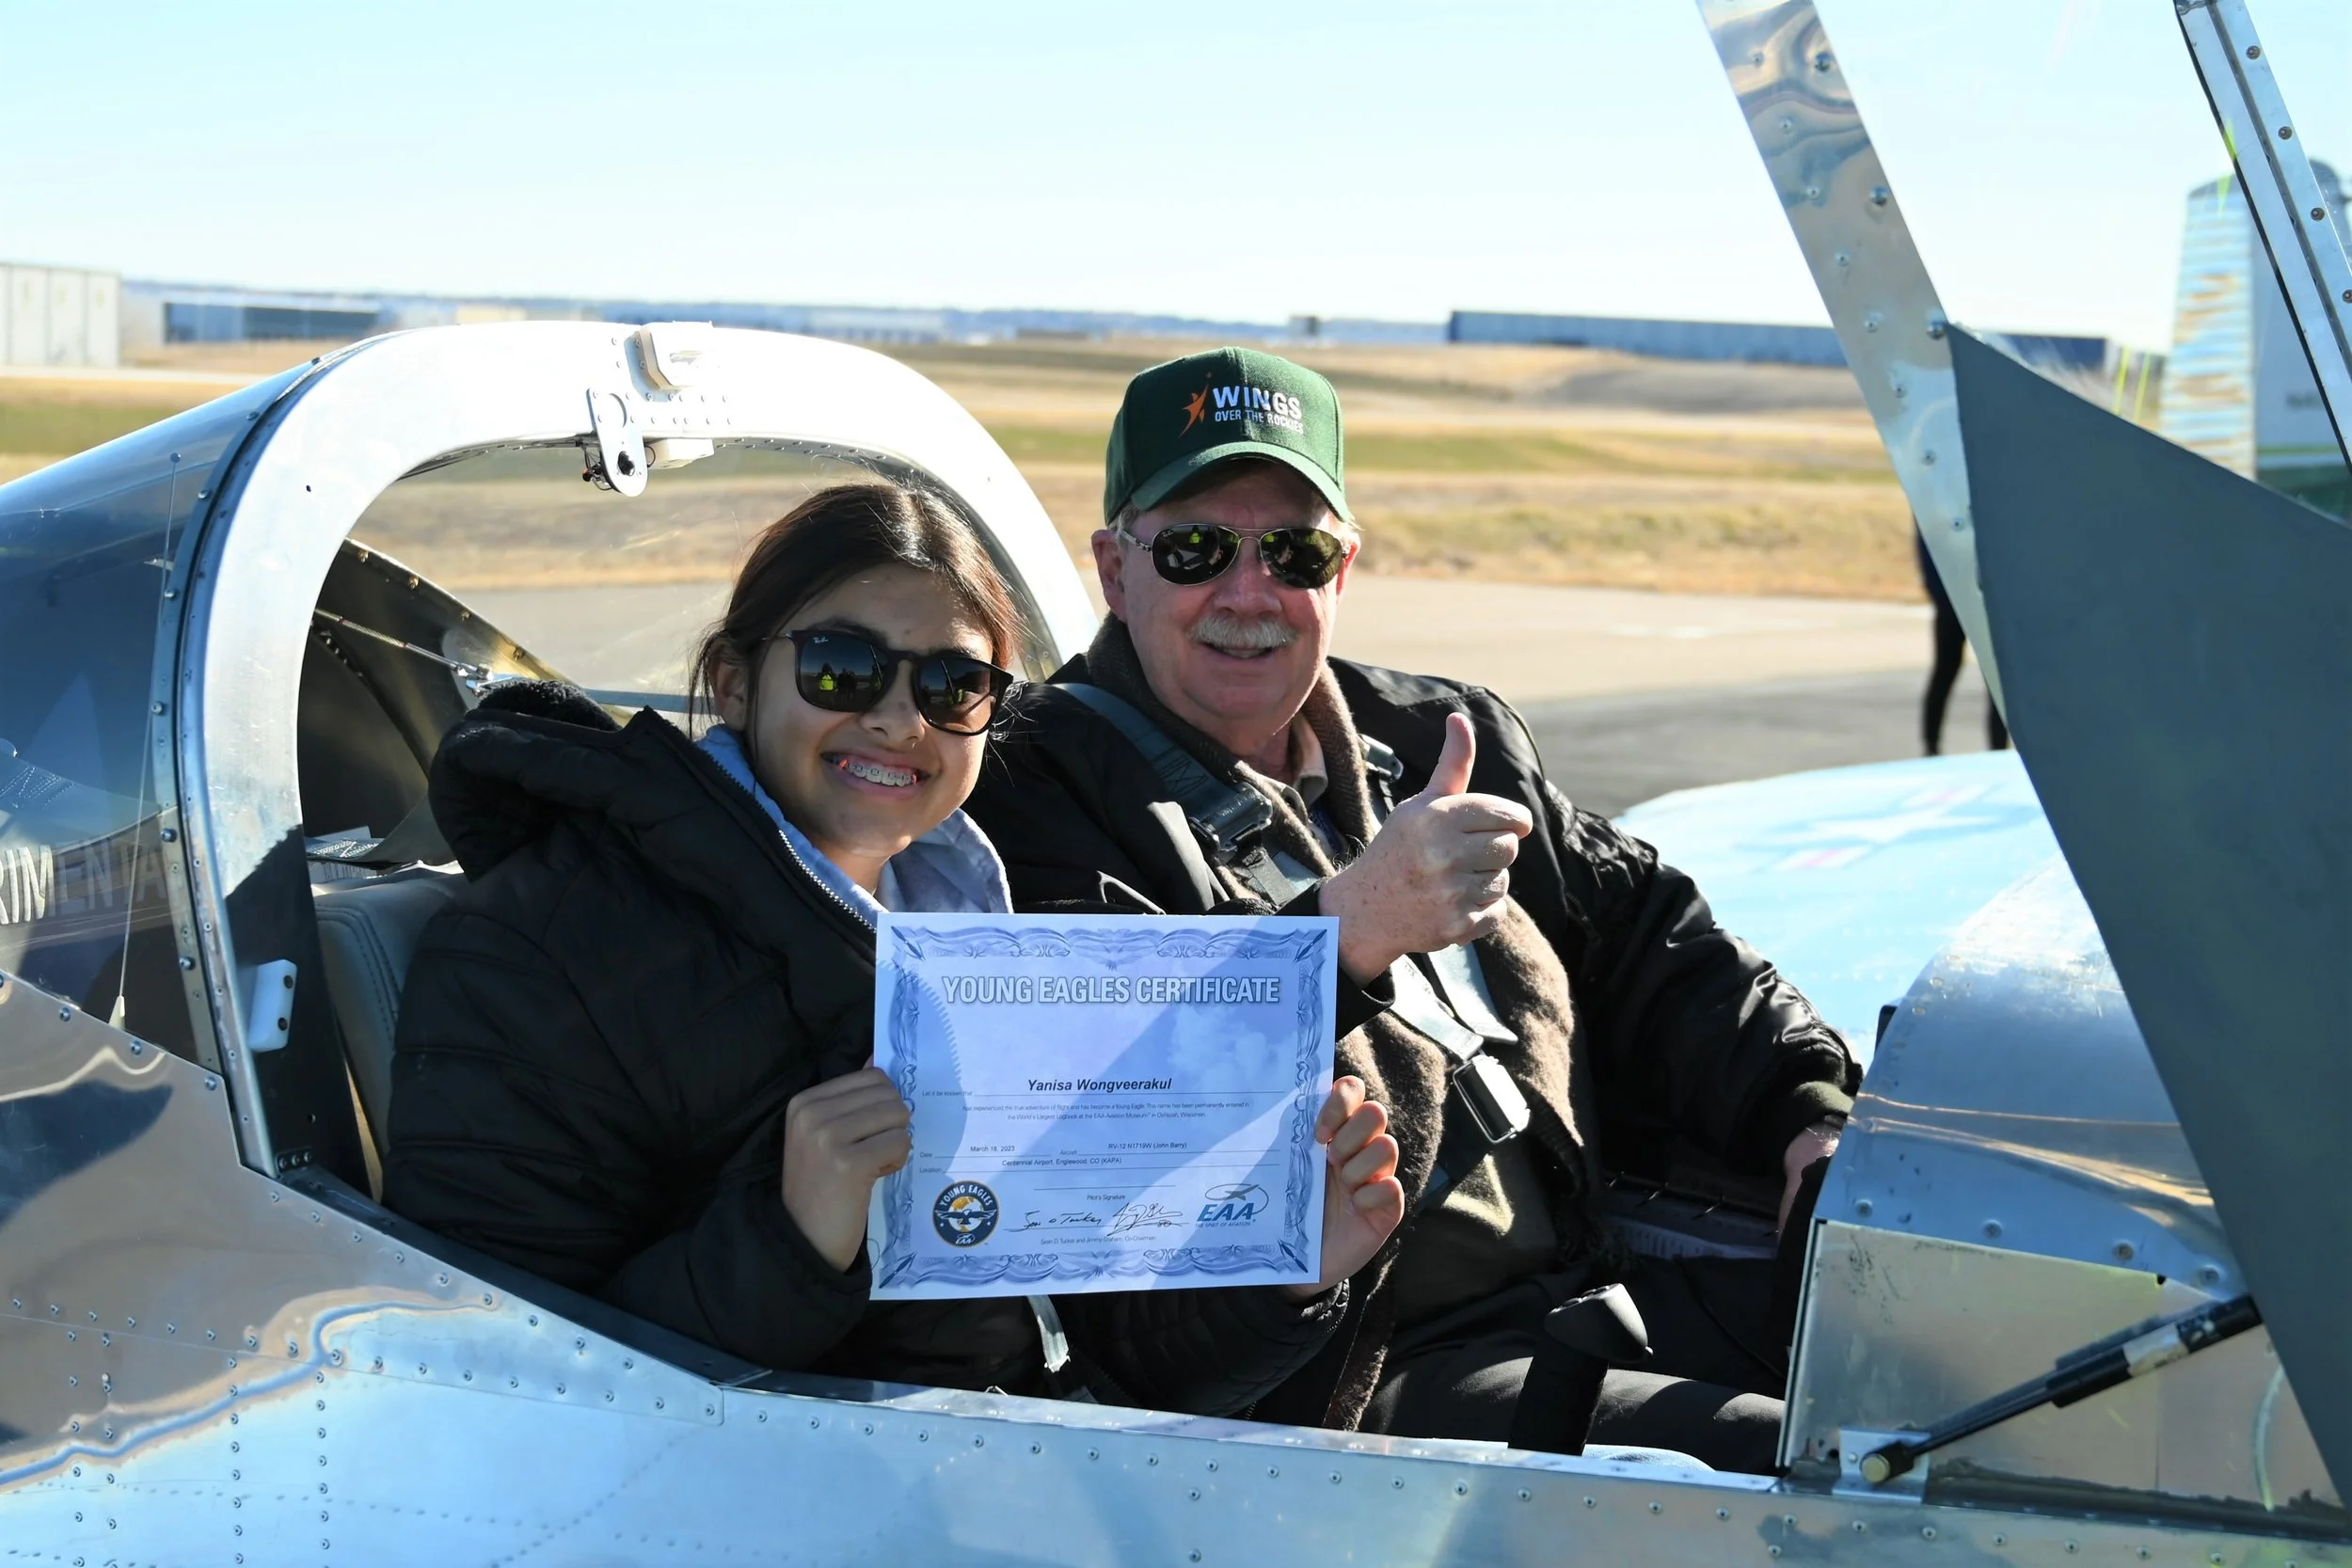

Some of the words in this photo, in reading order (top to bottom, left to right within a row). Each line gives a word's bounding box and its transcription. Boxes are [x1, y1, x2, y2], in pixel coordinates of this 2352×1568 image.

[1212, 385, 1302, 420] WINGS
[1215, 409, 1242, 422] OVER
[1245, 409, 1265, 423] THE
[941, 975, 1033, 1004] YOUNG
[1038, 975, 1131, 1004] EAGLES
[1135, 975, 1280, 1004] CERTIFICATE
[1027, 1079, 1073, 1092] Yanisa
[1076, 1078, 1172, 1093] Wongveerakul
[1101, 1157, 1121, 1165] (KAPA)
[940, 1185, 965, 1206] YOUNG
[968, 1184, 993, 1206] EAGLES
[1197, 1202, 1254, 1222] EAA
